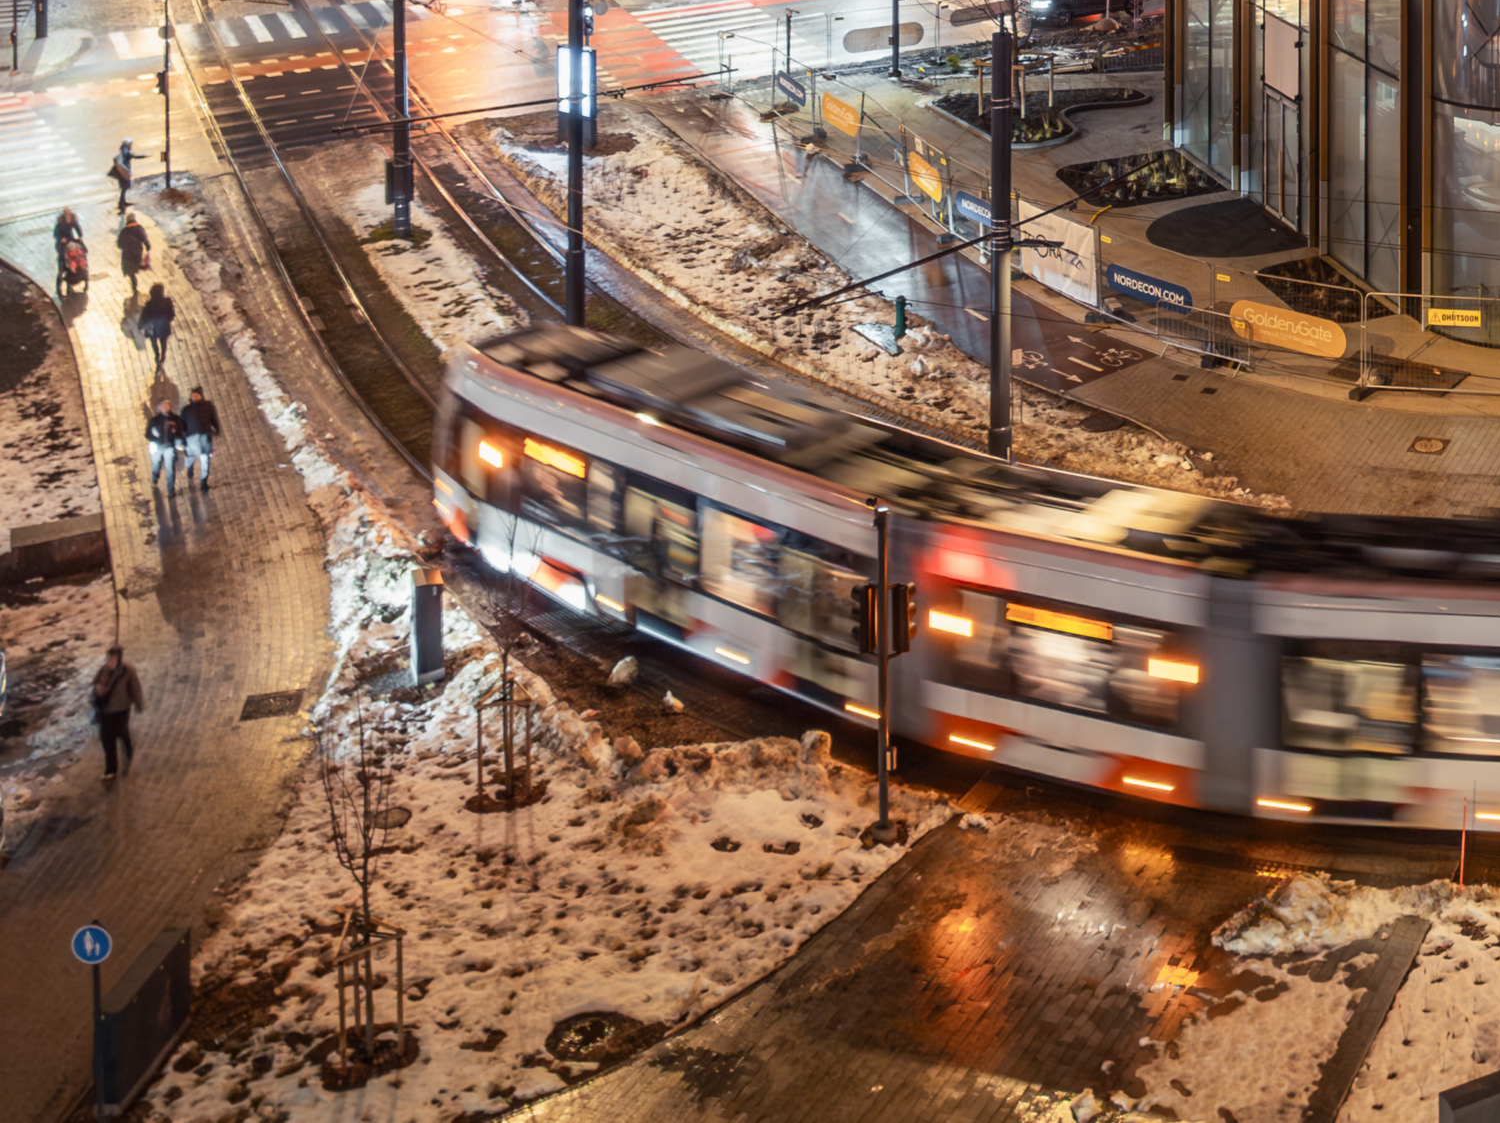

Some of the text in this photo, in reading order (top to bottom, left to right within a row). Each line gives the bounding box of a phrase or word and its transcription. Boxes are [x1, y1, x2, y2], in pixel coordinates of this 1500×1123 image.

[961, 198, 991, 219] NORDECO
[1113, 272, 1184, 306] NORDECON.COM
[1441, 313, 1479, 323] OHUTSOON
